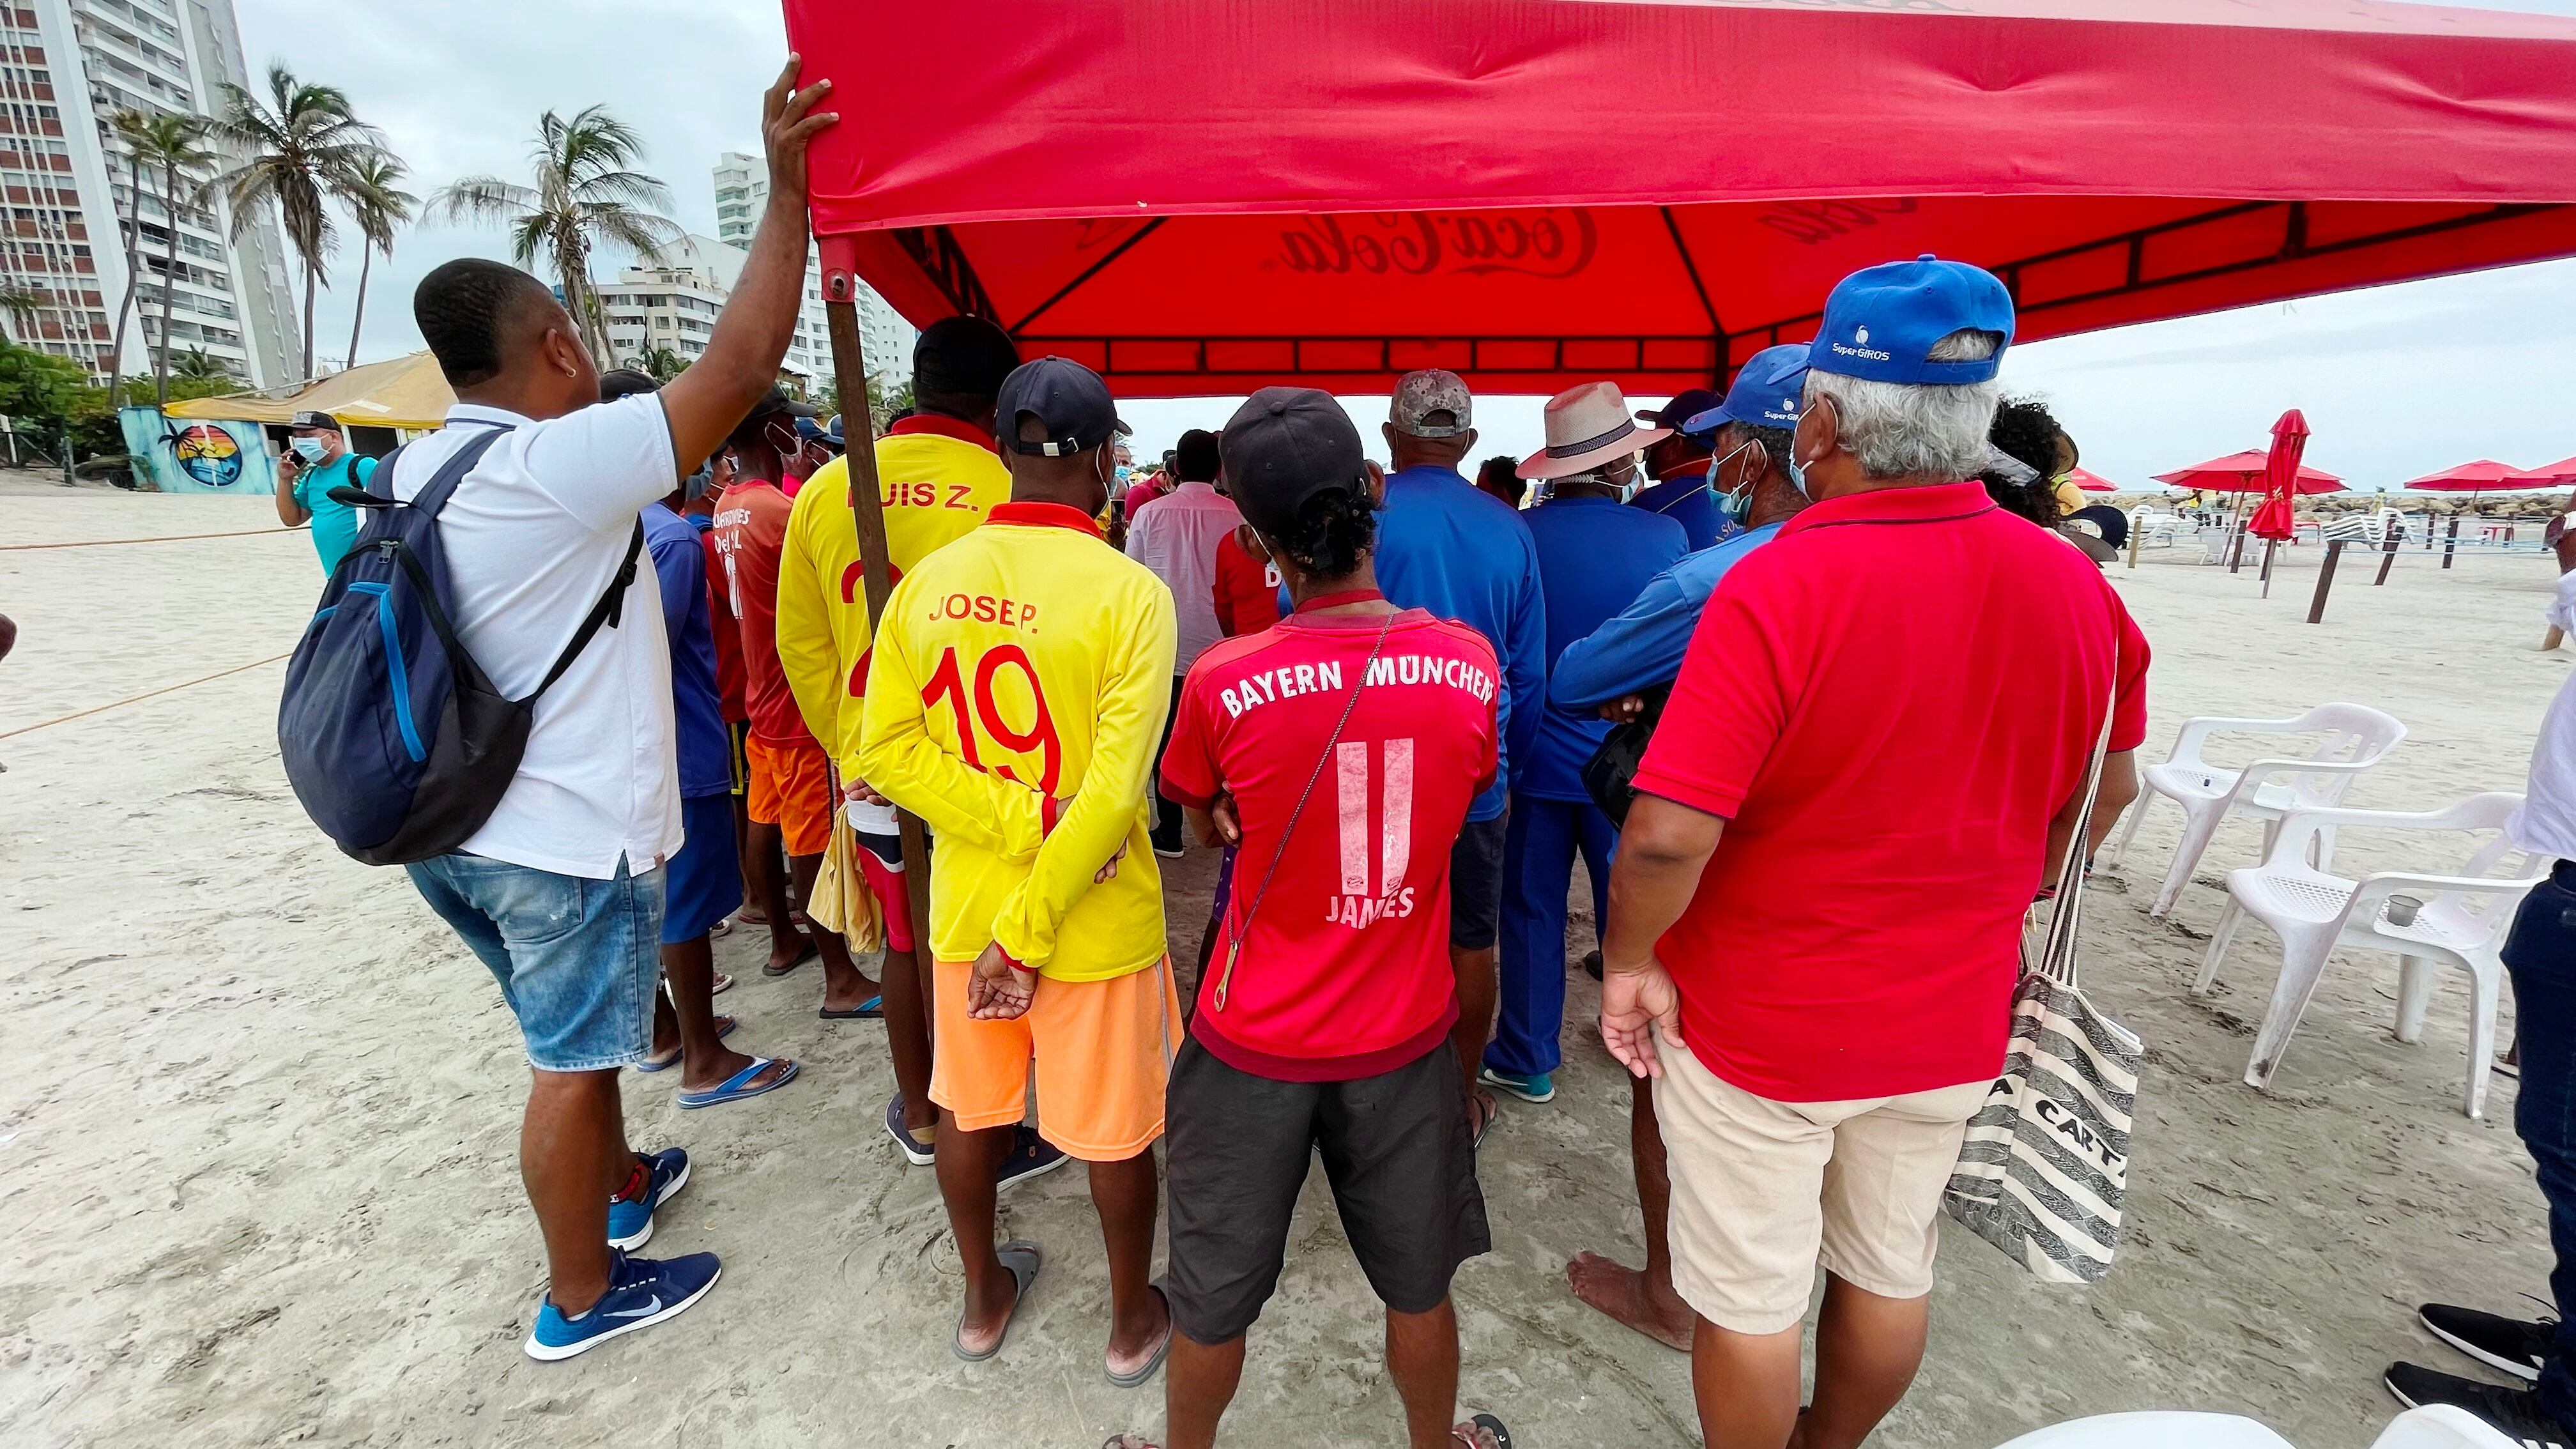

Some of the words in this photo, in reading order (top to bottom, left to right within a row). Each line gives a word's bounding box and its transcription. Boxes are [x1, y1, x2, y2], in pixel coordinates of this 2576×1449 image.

[848, 483, 935, 508] UIS
[921, 644, 1061, 797] 19
[1220, 661, 1343, 719] BAYERN
[1365, 656, 1494, 707] MÜNCHEN
[1337, 737, 1414, 897] 11
[1326, 887, 1414, 930] JAMES
[2035, 1100, 2126, 1178] CART
